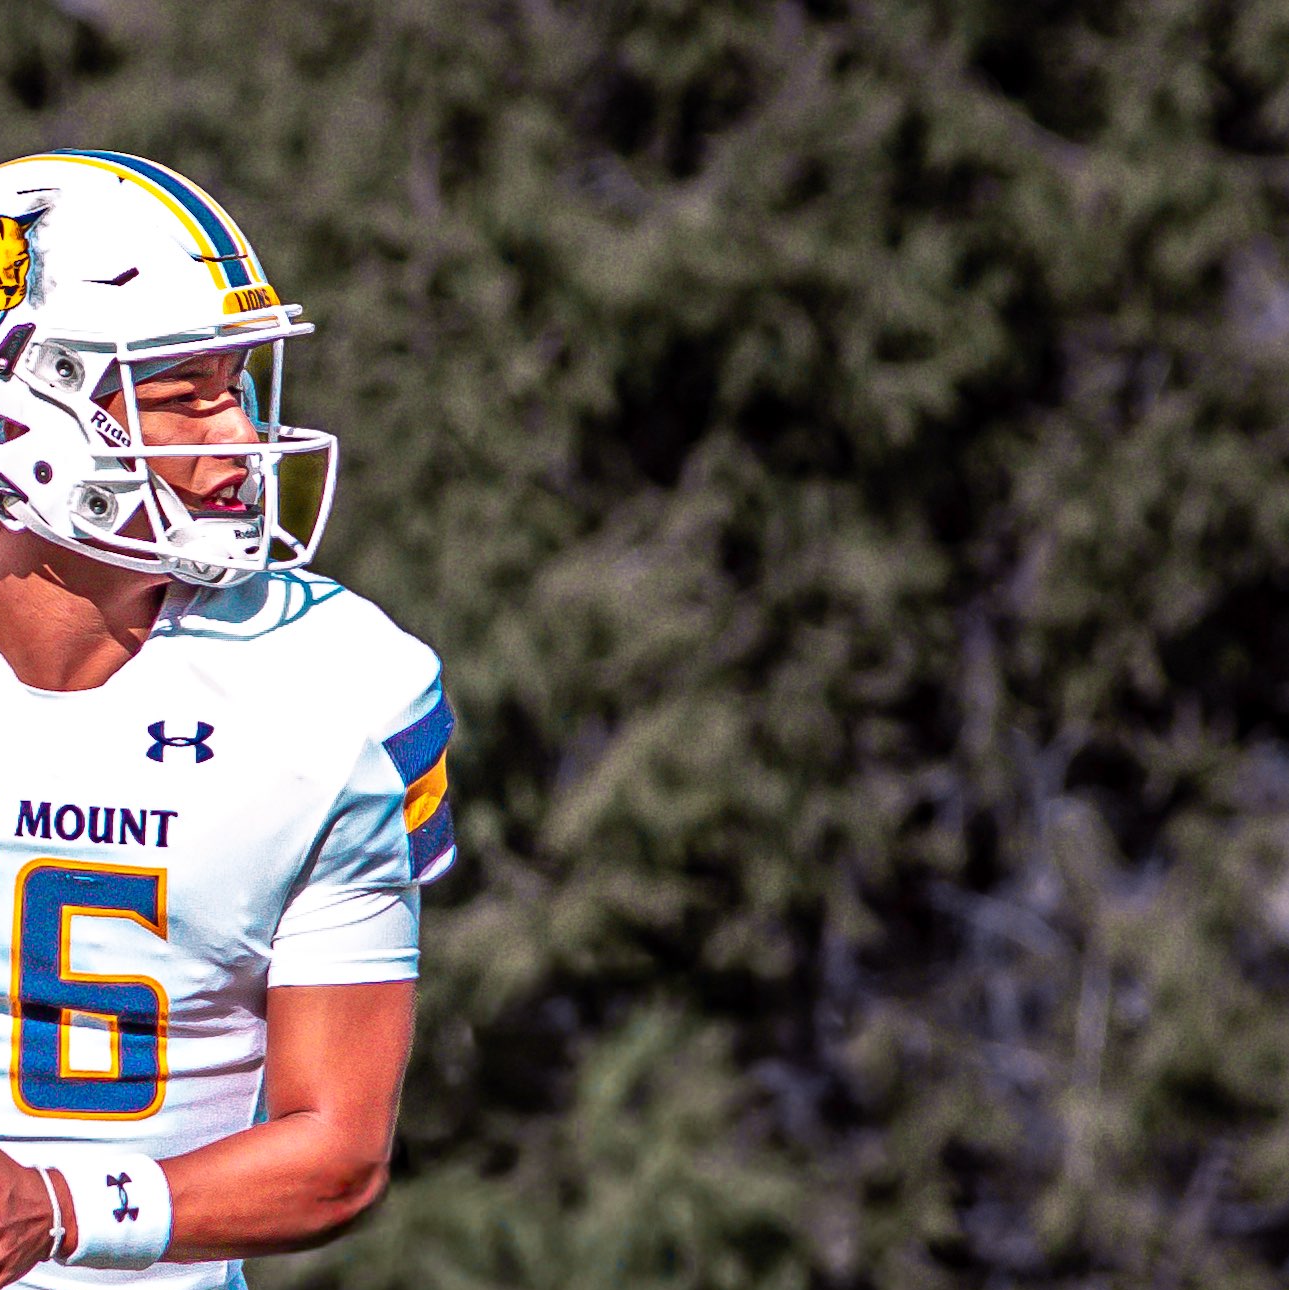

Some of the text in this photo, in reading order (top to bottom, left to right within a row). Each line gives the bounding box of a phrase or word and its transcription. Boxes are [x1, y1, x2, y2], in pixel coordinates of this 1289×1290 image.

[234, 288, 272, 312] LIONS
[90, 410, 131, 447] Ridd
[14, 800, 178, 847] MOUNT
